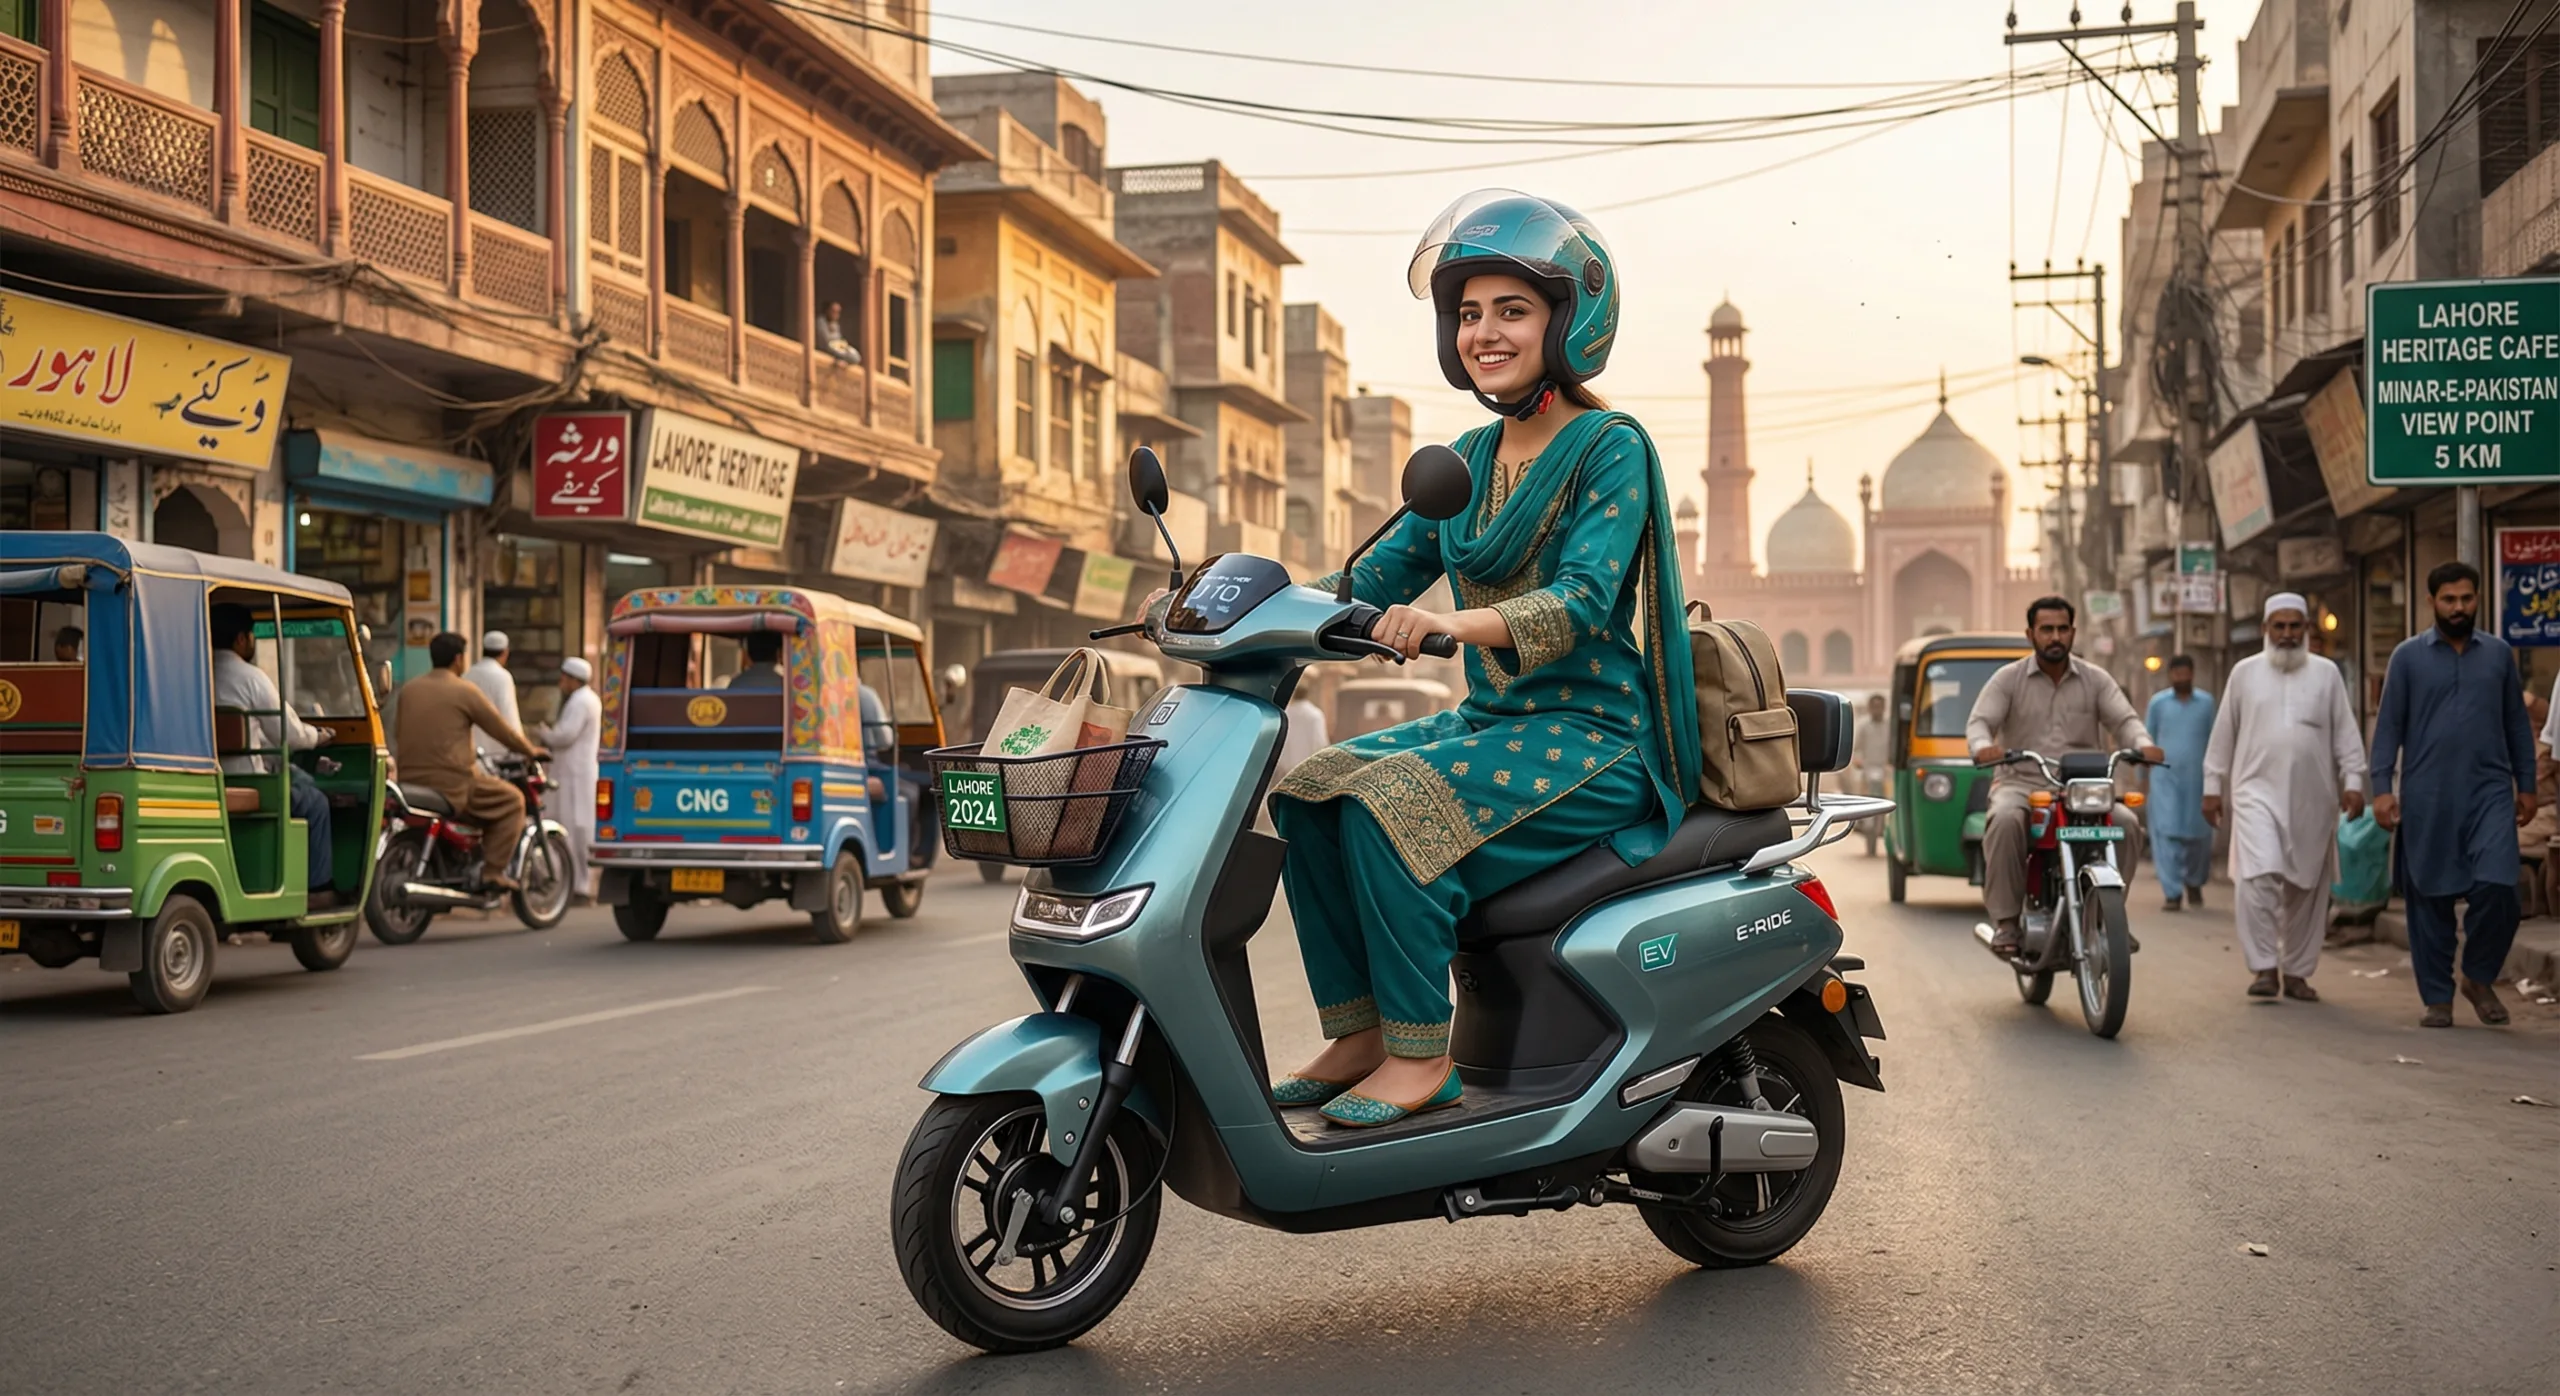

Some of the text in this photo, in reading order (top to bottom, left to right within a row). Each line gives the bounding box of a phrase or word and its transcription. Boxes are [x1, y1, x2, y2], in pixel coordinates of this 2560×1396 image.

[2418, 301, 2519, 329] LAHORE
[2382, 334, 2560, 363] HERITAGE CAFE
[2378, 376, 2558, 404] MINAR-E-PAKISTAN
[2401, 409, 2535, 436] VIEW POINT
[652, 426, 788, 499] LAHORE HERITAGE
[2434, 444, 2502, 470] 5 KM
[676, 787, 730, 813] CNG
[948, 778, 995, 796] LAHORE
[949, 798, 998, 826] 2024
[1735, 908, 1793, 942] E-RIDE
[1643, 933, 1678, 964] EV
